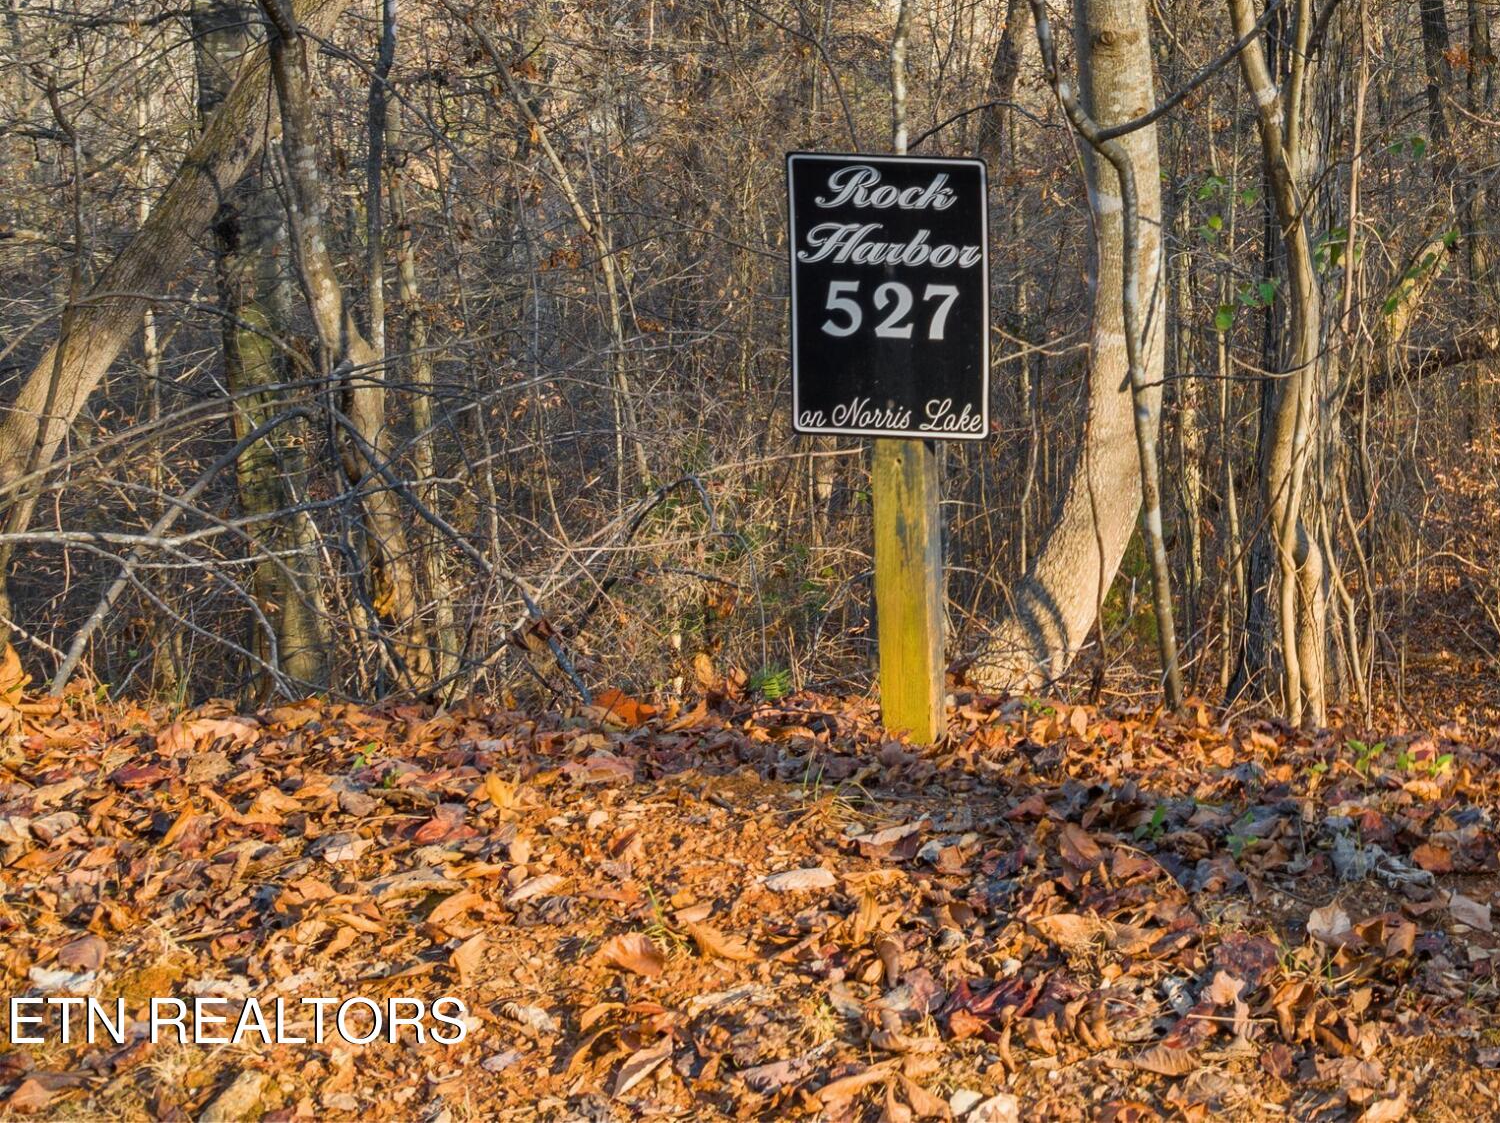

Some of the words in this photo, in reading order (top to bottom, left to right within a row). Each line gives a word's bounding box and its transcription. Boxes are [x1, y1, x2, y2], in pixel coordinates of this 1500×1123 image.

[814, 165, 958, 211] Rock
[797, 222, 983, 268] Harbor
[821, 280, 960, 340] 527
[799, 408, 826, 427] on
[832, 397, 912, 430] Norris
[919, 398, 983, 432] Lake
